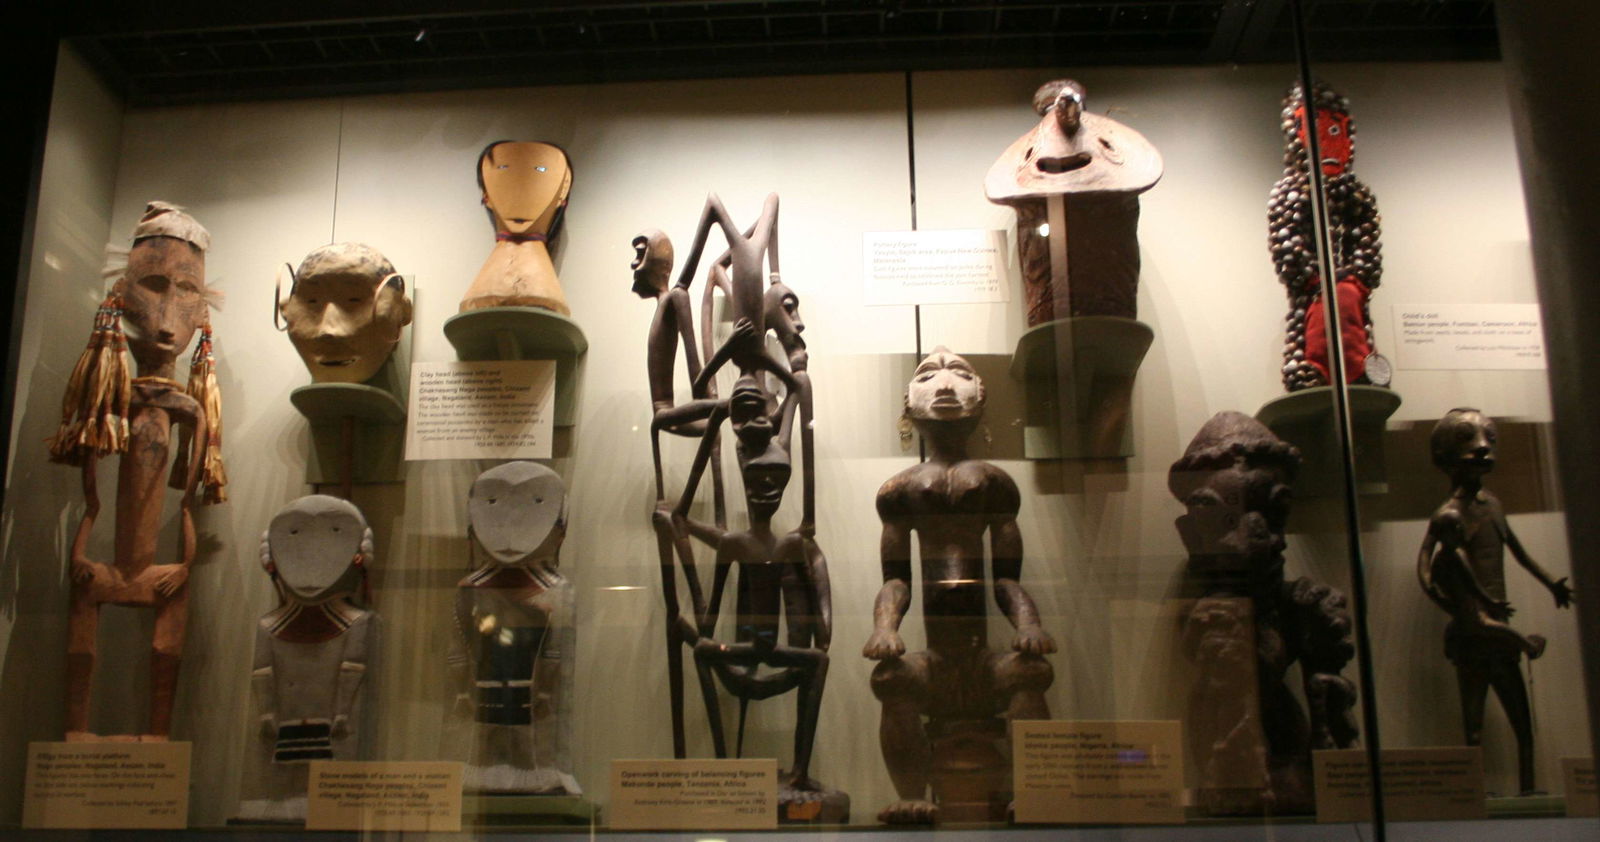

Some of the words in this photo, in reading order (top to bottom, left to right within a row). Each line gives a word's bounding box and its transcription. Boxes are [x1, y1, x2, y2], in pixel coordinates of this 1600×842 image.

[420, 371, 434, 379] Clay
[1080, 732, 1102, 740] figure
[621, 770, 659, 779] Openwork
[661, 770, 689, 779] carving
[691, 770, 699, 778] of
[700, 770, 737, 779] balancing
[739, 770, 766, 779] figures
[621, 780, 655, 788] Makonde
[723, 780, 746, 788] Africa
